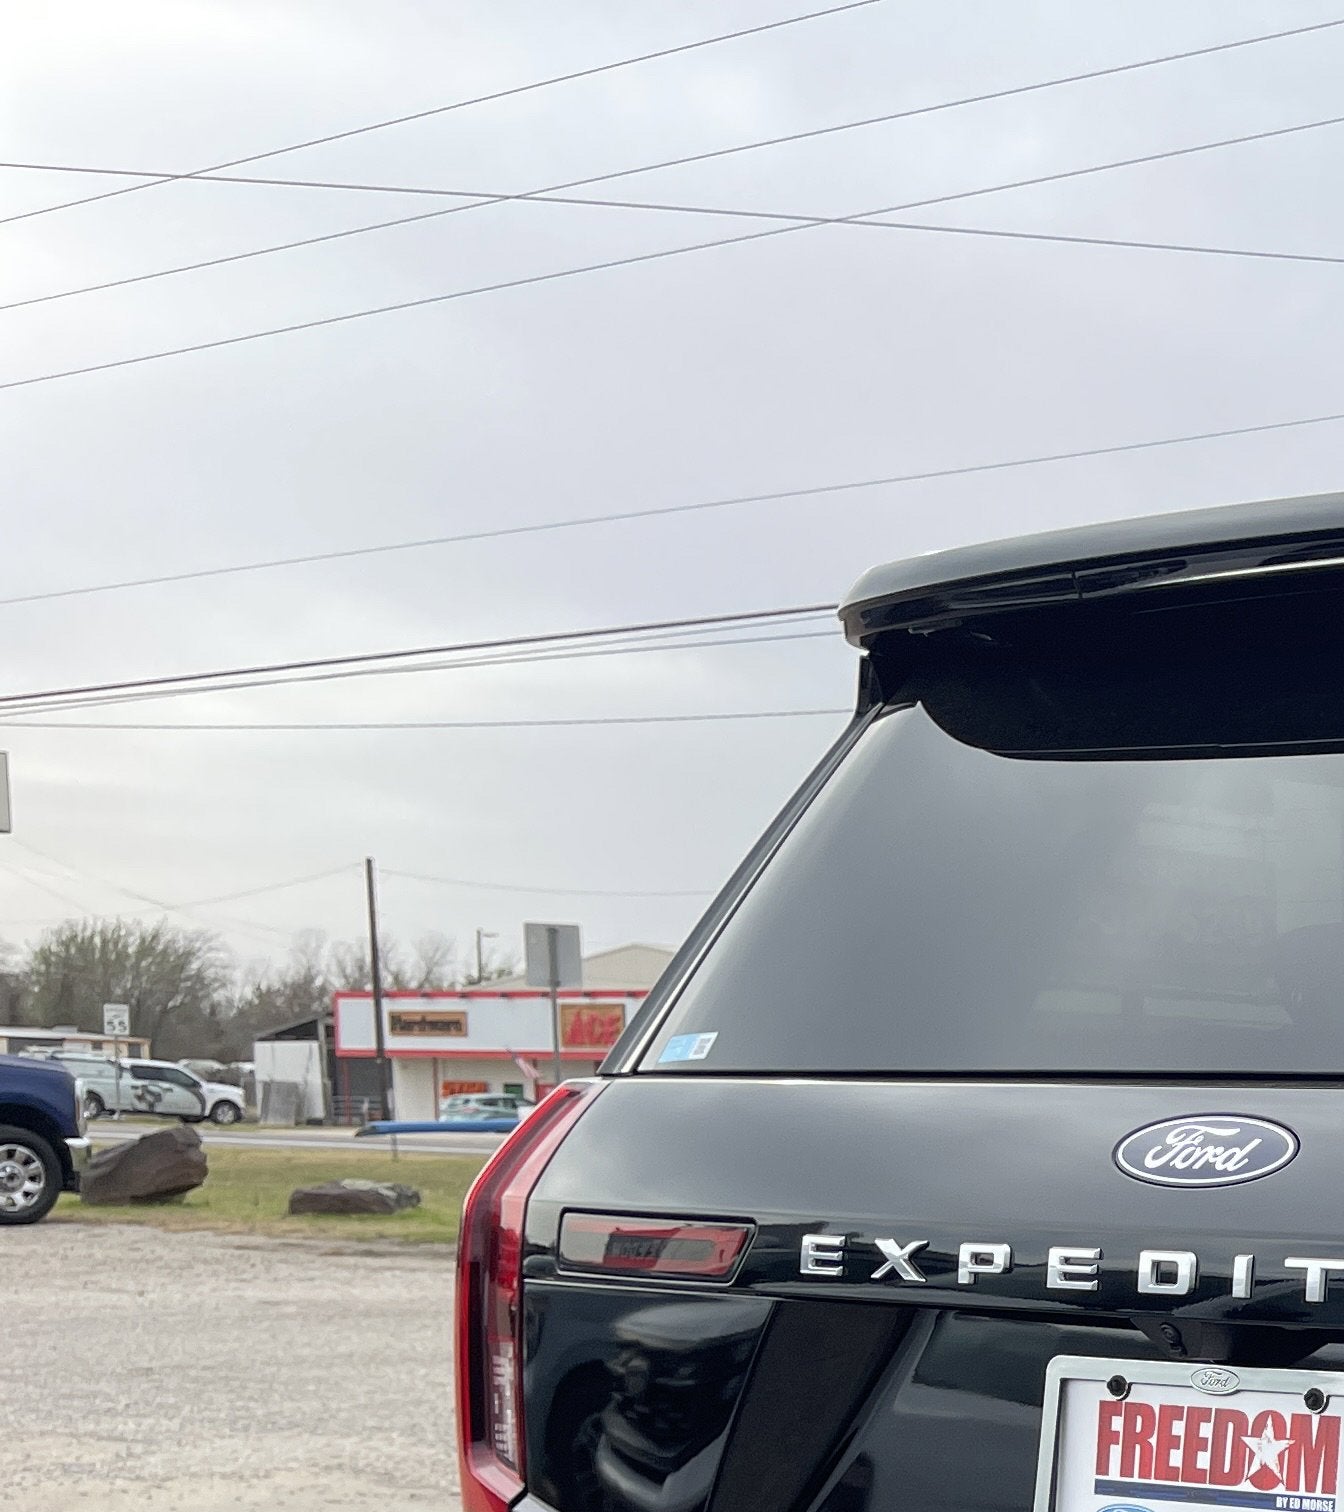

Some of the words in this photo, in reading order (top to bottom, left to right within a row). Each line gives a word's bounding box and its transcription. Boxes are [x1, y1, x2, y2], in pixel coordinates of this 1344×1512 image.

[564, 1009, 622, 1045] ACE
[1144, 1124, 1262, 1172] Ford
[1200, 1370, 1231, 1388] Ford
[1094, 1400, 1342, 1495] FREEDOM
[1276, 1496, 1288, 1509] BY
[1289, 1497, 1301, 1510] ED
[1301, 1498, 1334, 1512] MORSE
